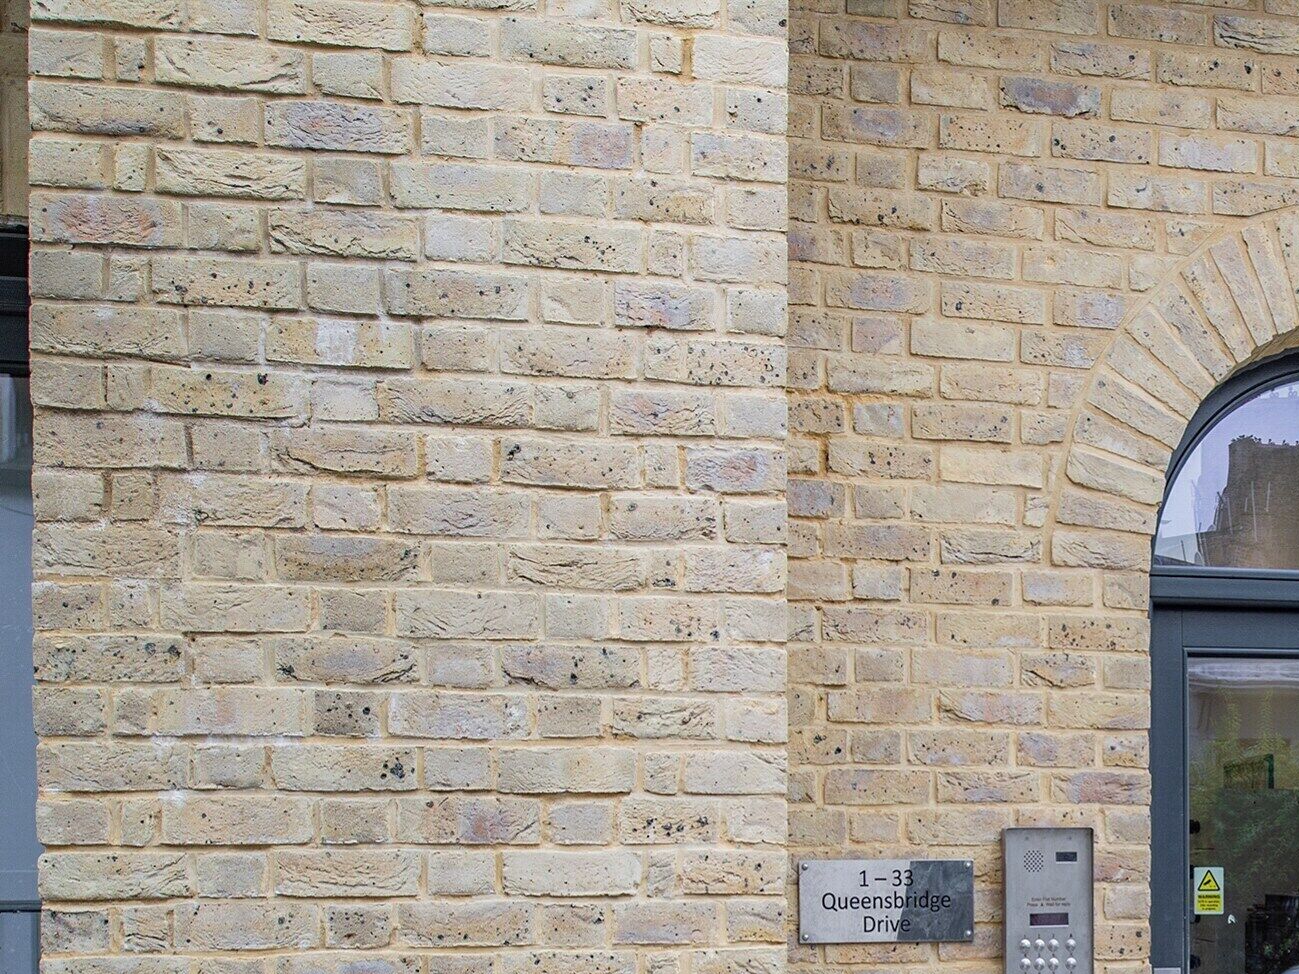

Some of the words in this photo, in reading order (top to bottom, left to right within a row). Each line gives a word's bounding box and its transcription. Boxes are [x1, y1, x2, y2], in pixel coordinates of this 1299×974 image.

[859, 870, 869, 887] 1
[892, 869, 914, 887] 33
[822, 890, 951, 913] Queensbridge
[863, 915, 911, 933] Drive
